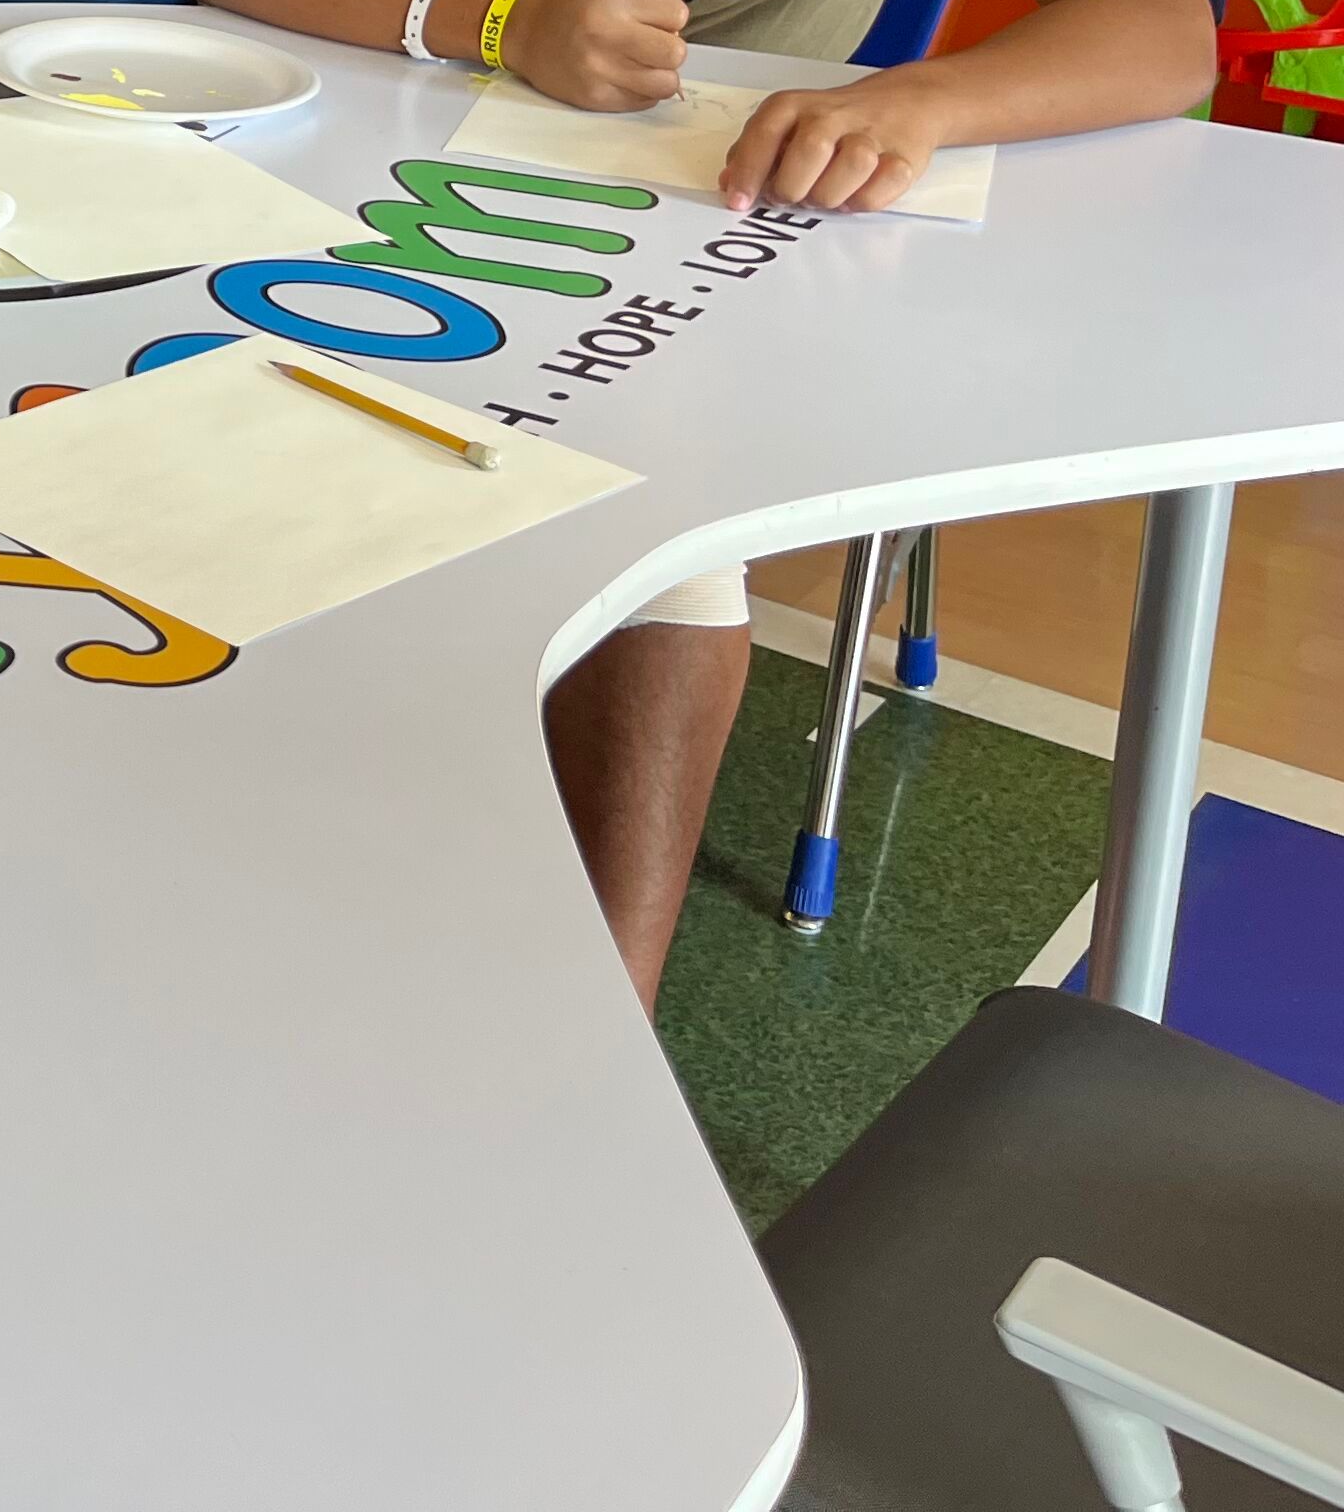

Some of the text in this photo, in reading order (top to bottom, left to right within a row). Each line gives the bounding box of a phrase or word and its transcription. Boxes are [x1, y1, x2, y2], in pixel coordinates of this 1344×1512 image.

[484, 12, 504, 53] RISK
[537, 207, 823, 385] HOPE LOVE
